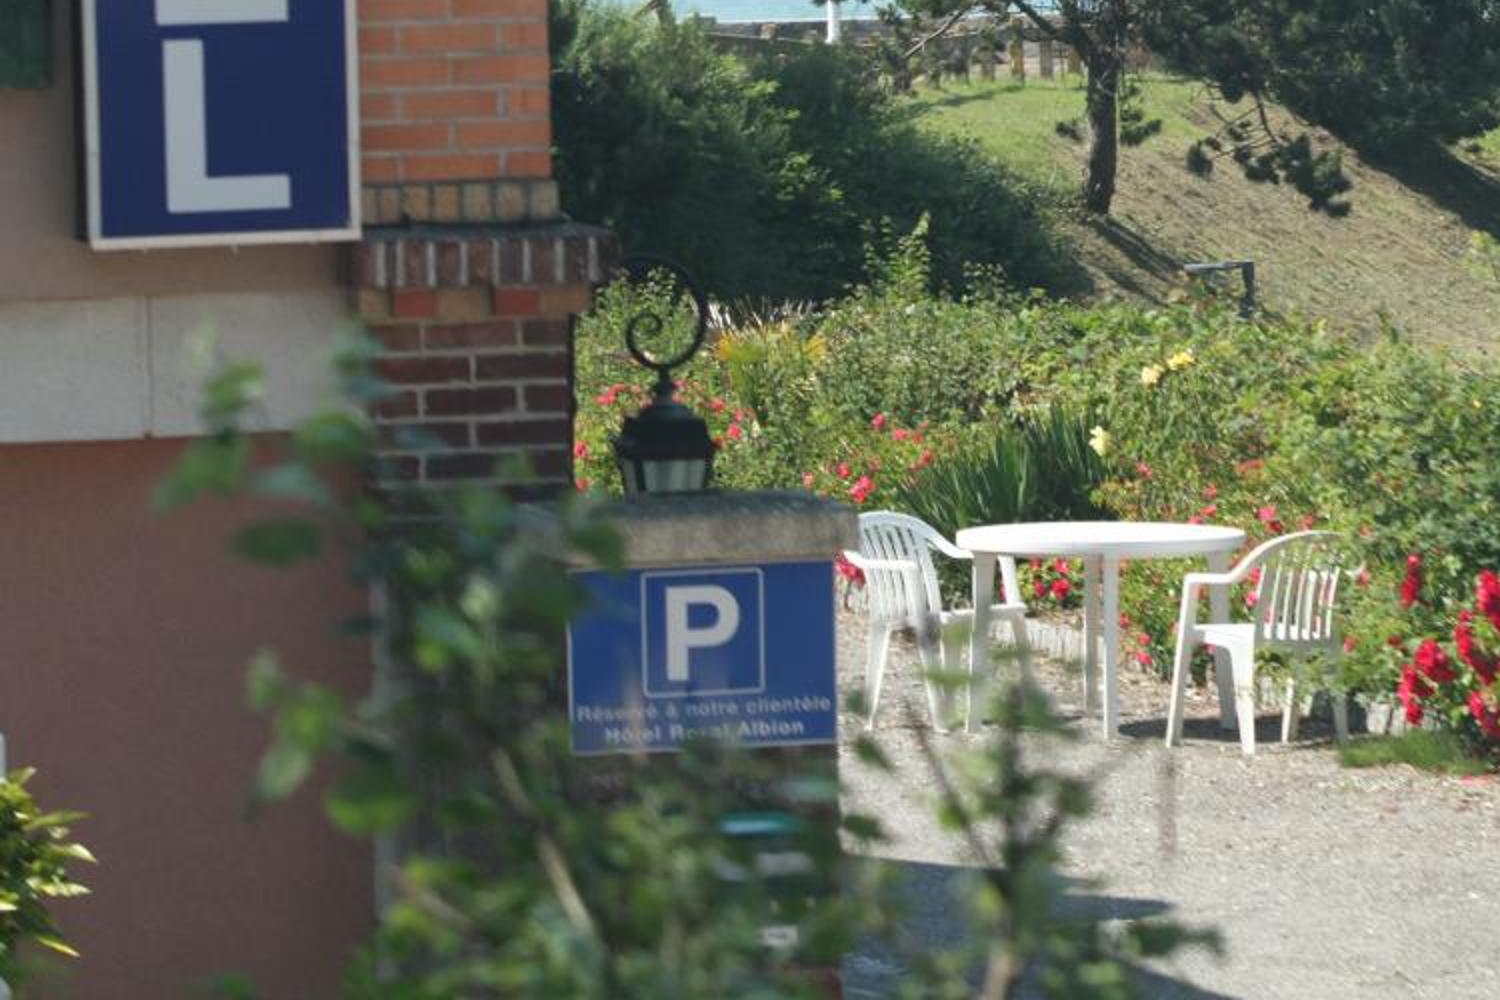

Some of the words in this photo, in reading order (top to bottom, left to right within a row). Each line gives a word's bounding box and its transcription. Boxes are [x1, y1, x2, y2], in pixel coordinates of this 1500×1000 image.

[665, 585, 740, 681] P
[577, 702, 657, 722] Résevé
[686, 699, 738, 716] notre
[746, 695, 832, 713] clientèle
[604, 723, 661, 744] Hôel
[738, 718, 805, 738] Albion
